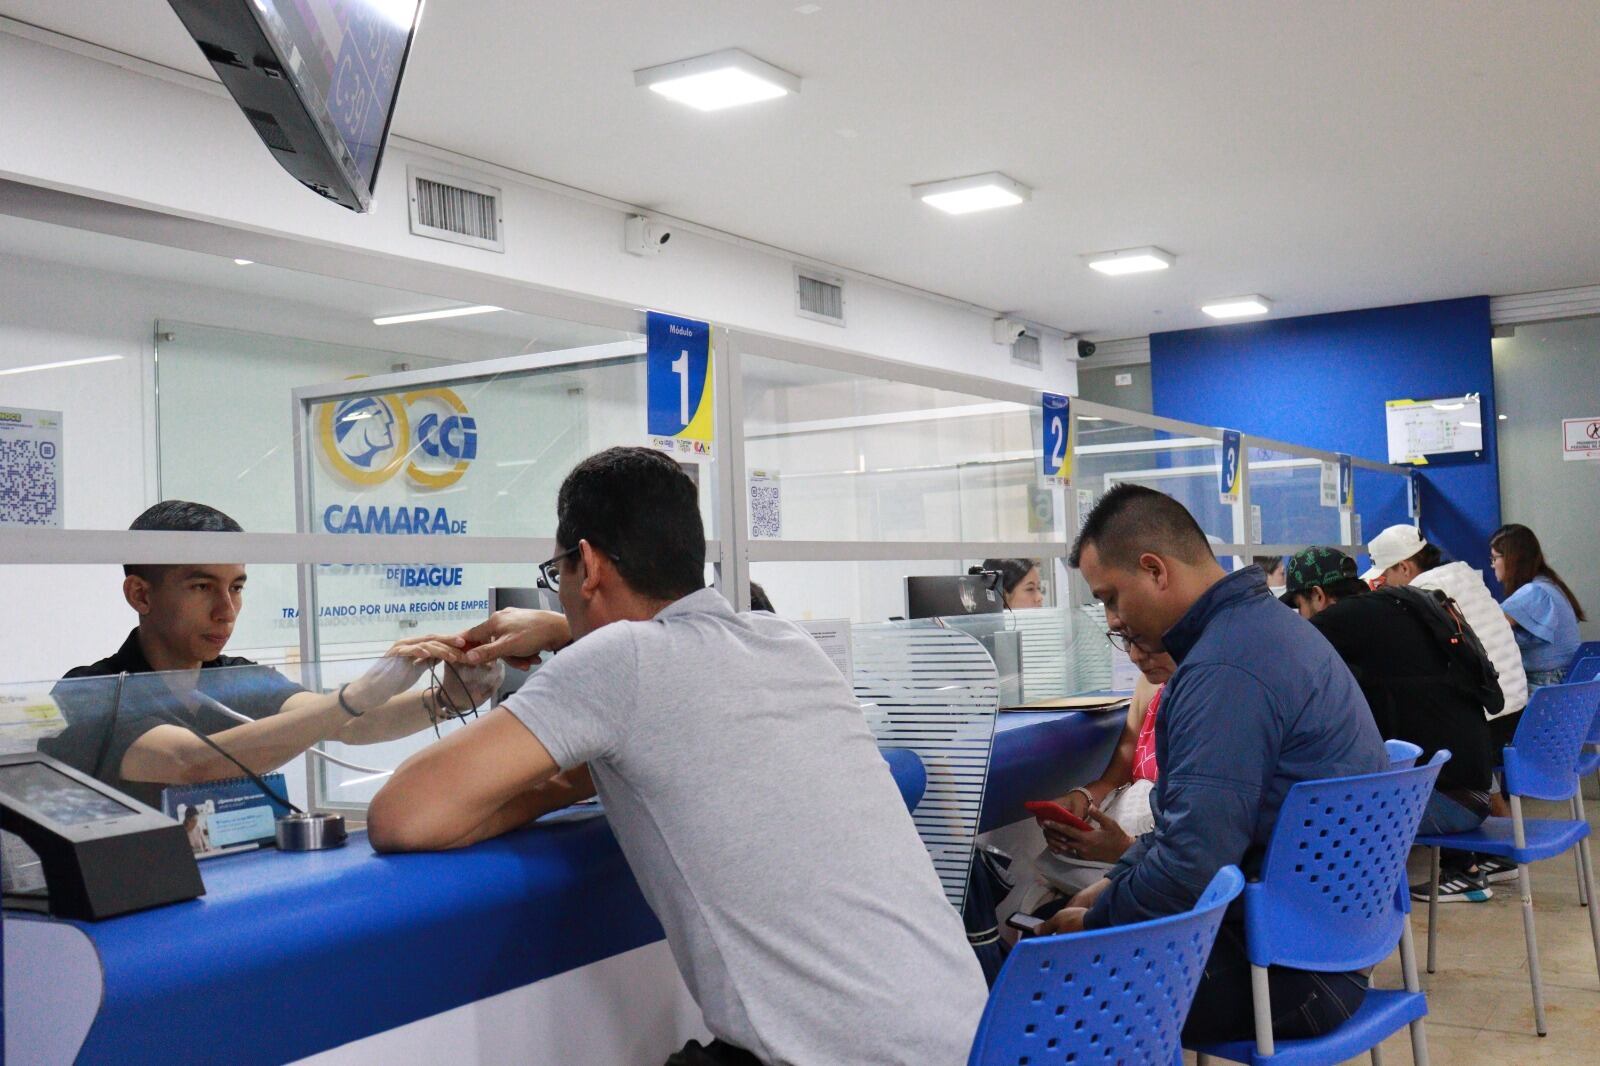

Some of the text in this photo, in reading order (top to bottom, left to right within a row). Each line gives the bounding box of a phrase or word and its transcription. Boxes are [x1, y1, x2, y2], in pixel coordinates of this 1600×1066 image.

[669, 324, 693, 337] Módulo
[671, 350, 689, 426] 1
[1051, 415, 1063, 467] 2
[1227, 447, 1235, 488] 3
[323, 504, 467, 535] CAMARA DE
[387, 567, 463, 588] DE IBAGUE
[360, 604, 381, 615] POR
[384, 602, 406, 614] UNA
[409, 599, 445, 613] REGIÓN
[447, 601, 459, 611] DE
